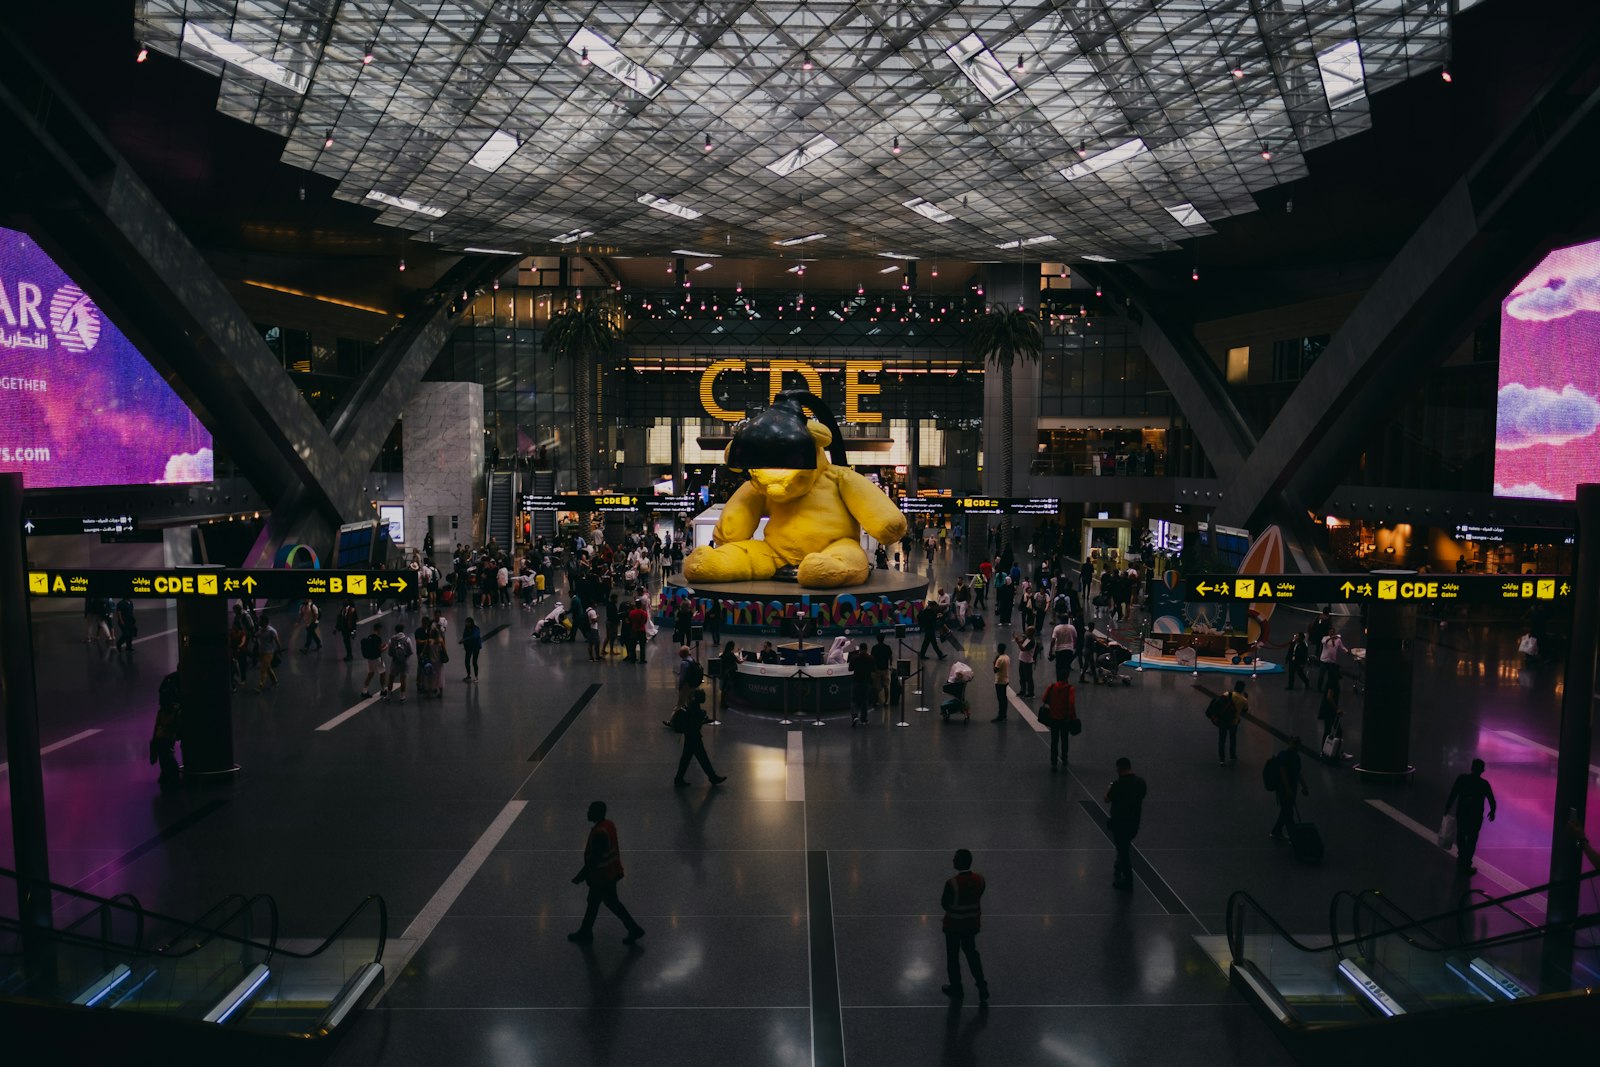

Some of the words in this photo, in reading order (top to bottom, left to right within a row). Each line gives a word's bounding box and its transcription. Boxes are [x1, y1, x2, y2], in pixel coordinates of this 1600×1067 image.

[699, 358, 883, 423] CDE
[0, 447, 50, 462] s.com
[603, 496, 621, 505] CDE
[973, 499, 990, 507] CDE
[53, 576, 67, 592] A
[154, 576, 195, 593] CDE
[329, 577, 343, 593] B
[1257, 581, 1273, 597] A
[1400, 582, 1439, 598] CDE
[1521, 582, 1534, 598] B
